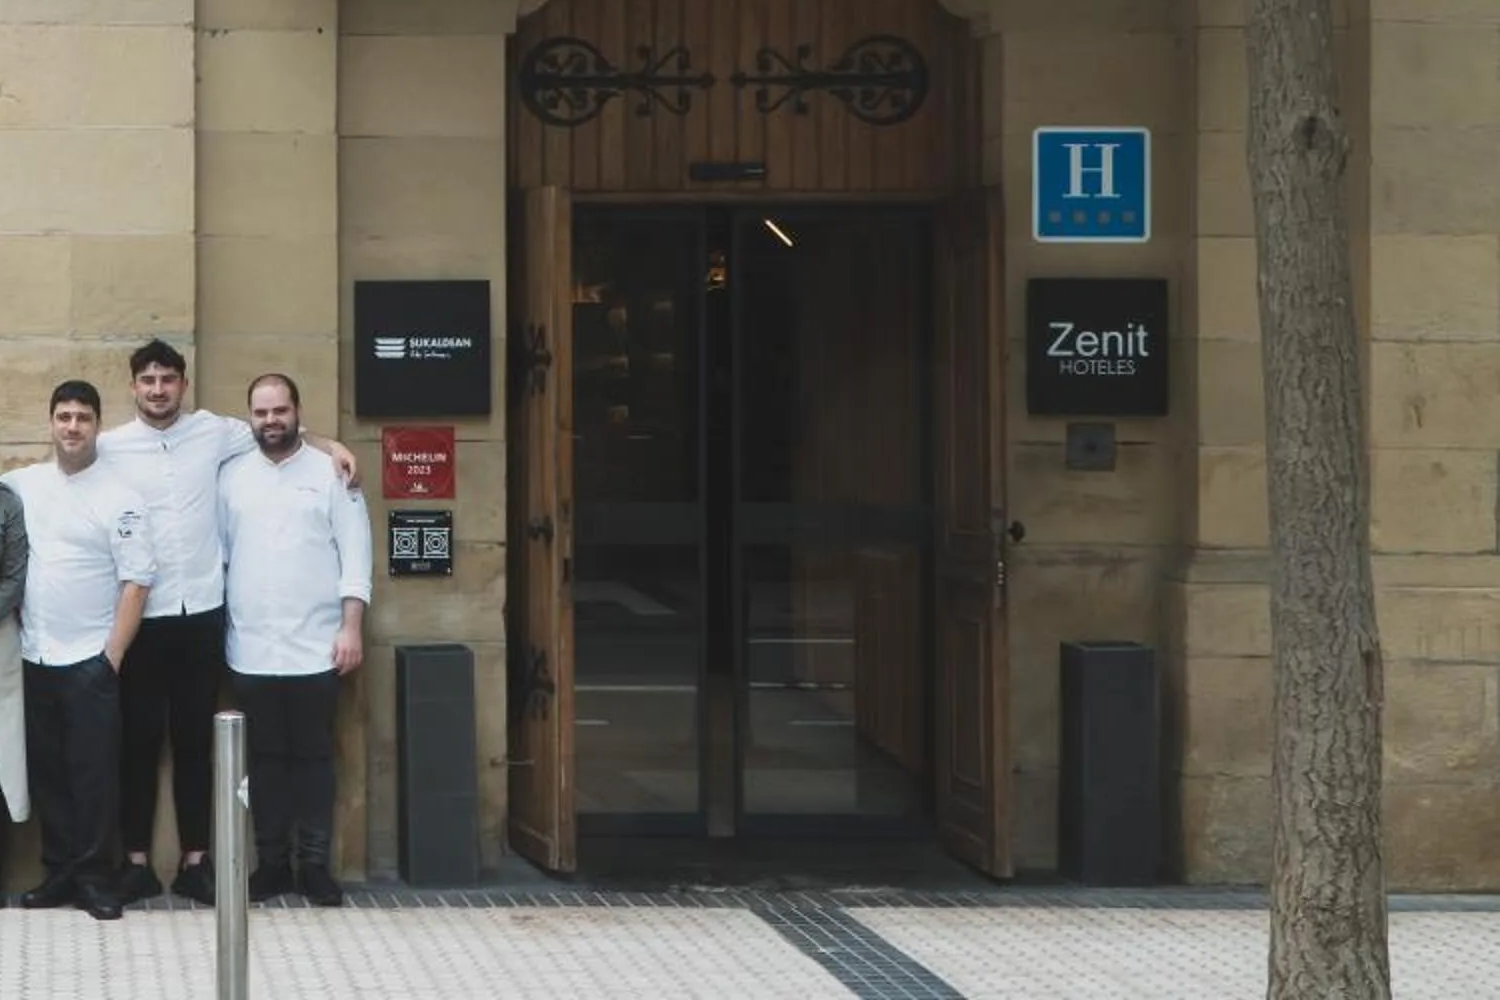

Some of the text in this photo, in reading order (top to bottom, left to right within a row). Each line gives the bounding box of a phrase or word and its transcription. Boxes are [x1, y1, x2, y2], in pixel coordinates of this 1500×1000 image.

[1061, 143, 1121, 199] H
[1047, 322, 1150, 357] Zenit
[1059, 359, 1136, 375] HOTELES
[391, 452, 447, 463] MICHELIN
